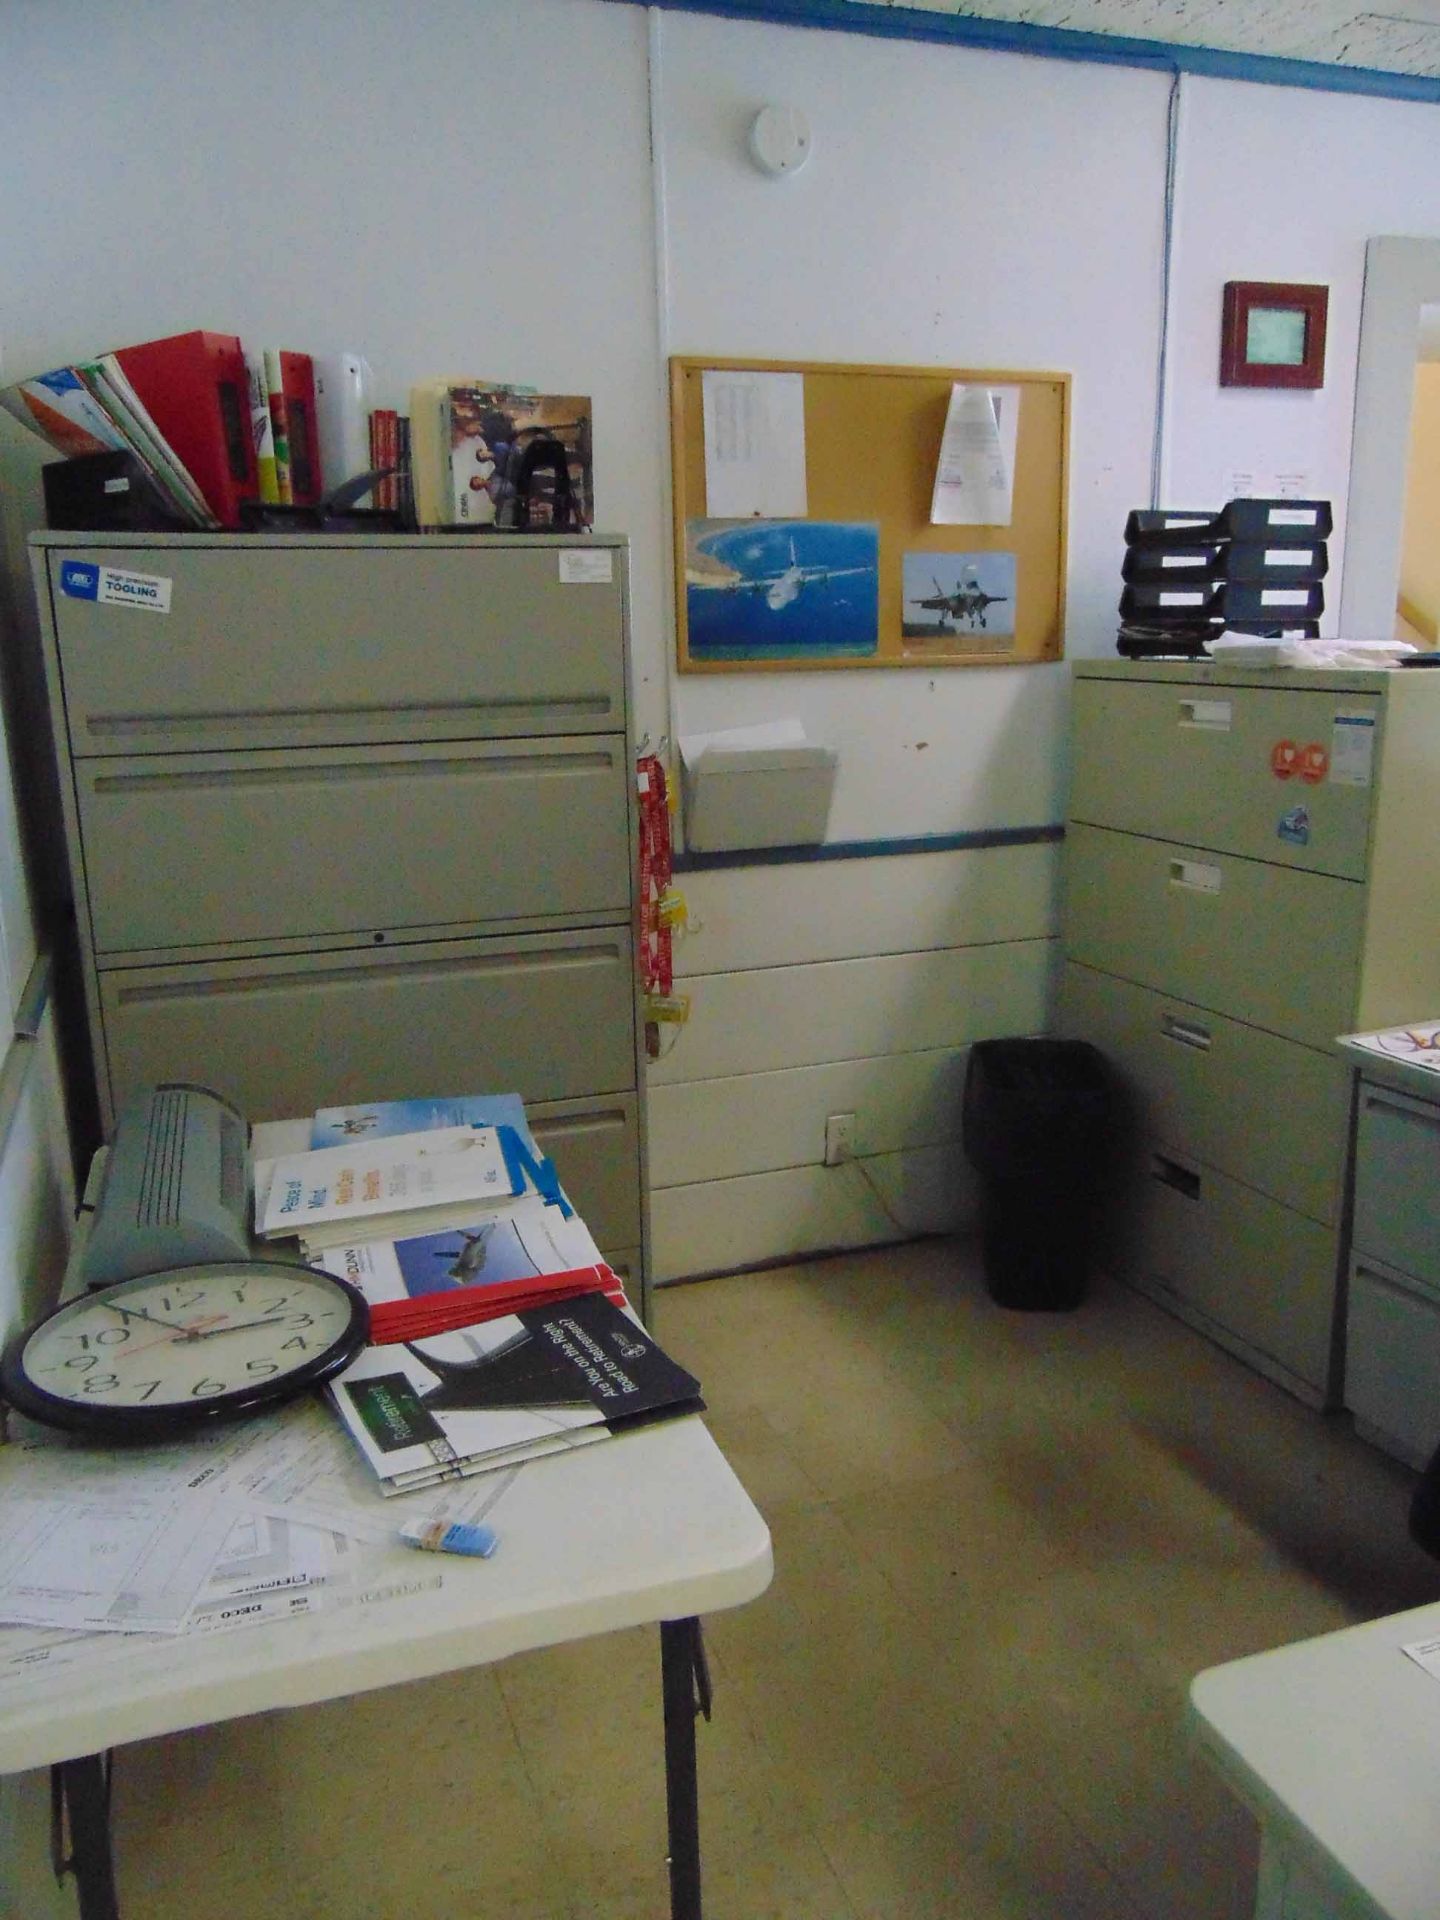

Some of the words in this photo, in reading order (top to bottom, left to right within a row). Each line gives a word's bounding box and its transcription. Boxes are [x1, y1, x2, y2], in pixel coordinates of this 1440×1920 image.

[105, 581, 158, 598] TOOLING
[286, 1180, 301, 1189] of
[280, 1189, 300, 1213] Peace
[159, 1291, 206, 1312] 12
[260, 1297, 289, 1315] 2
[288, 1312, 315, 1331] 3
[80, 1327, 131, 1351] 10
[280, 1335, 307, 1351] 4
[541, 1321, 568, 1345] Right
[558, 1317, 608, 1363] Retirement?
[562, 1342, 580, 1358] the
[64, 1354, 99, 1373] 9
[246, 1357, 280, 1378] 5
[574, 1355, 590, 1368] on
[604, 1360, 618, 1377] to
[82, 1373, 121, 1395] 8
[190, 1377, 228, 1397] 6
[584, 1366, 601, 1387] You
[612, 1371, 640, 1394] Road
[134, 1379, 163, 1402] 7
[599, 1378, 620, 1399] Are
[368, 1384, 415, 1440] Retirement
[220, 1604, 263, 1620] DECO
